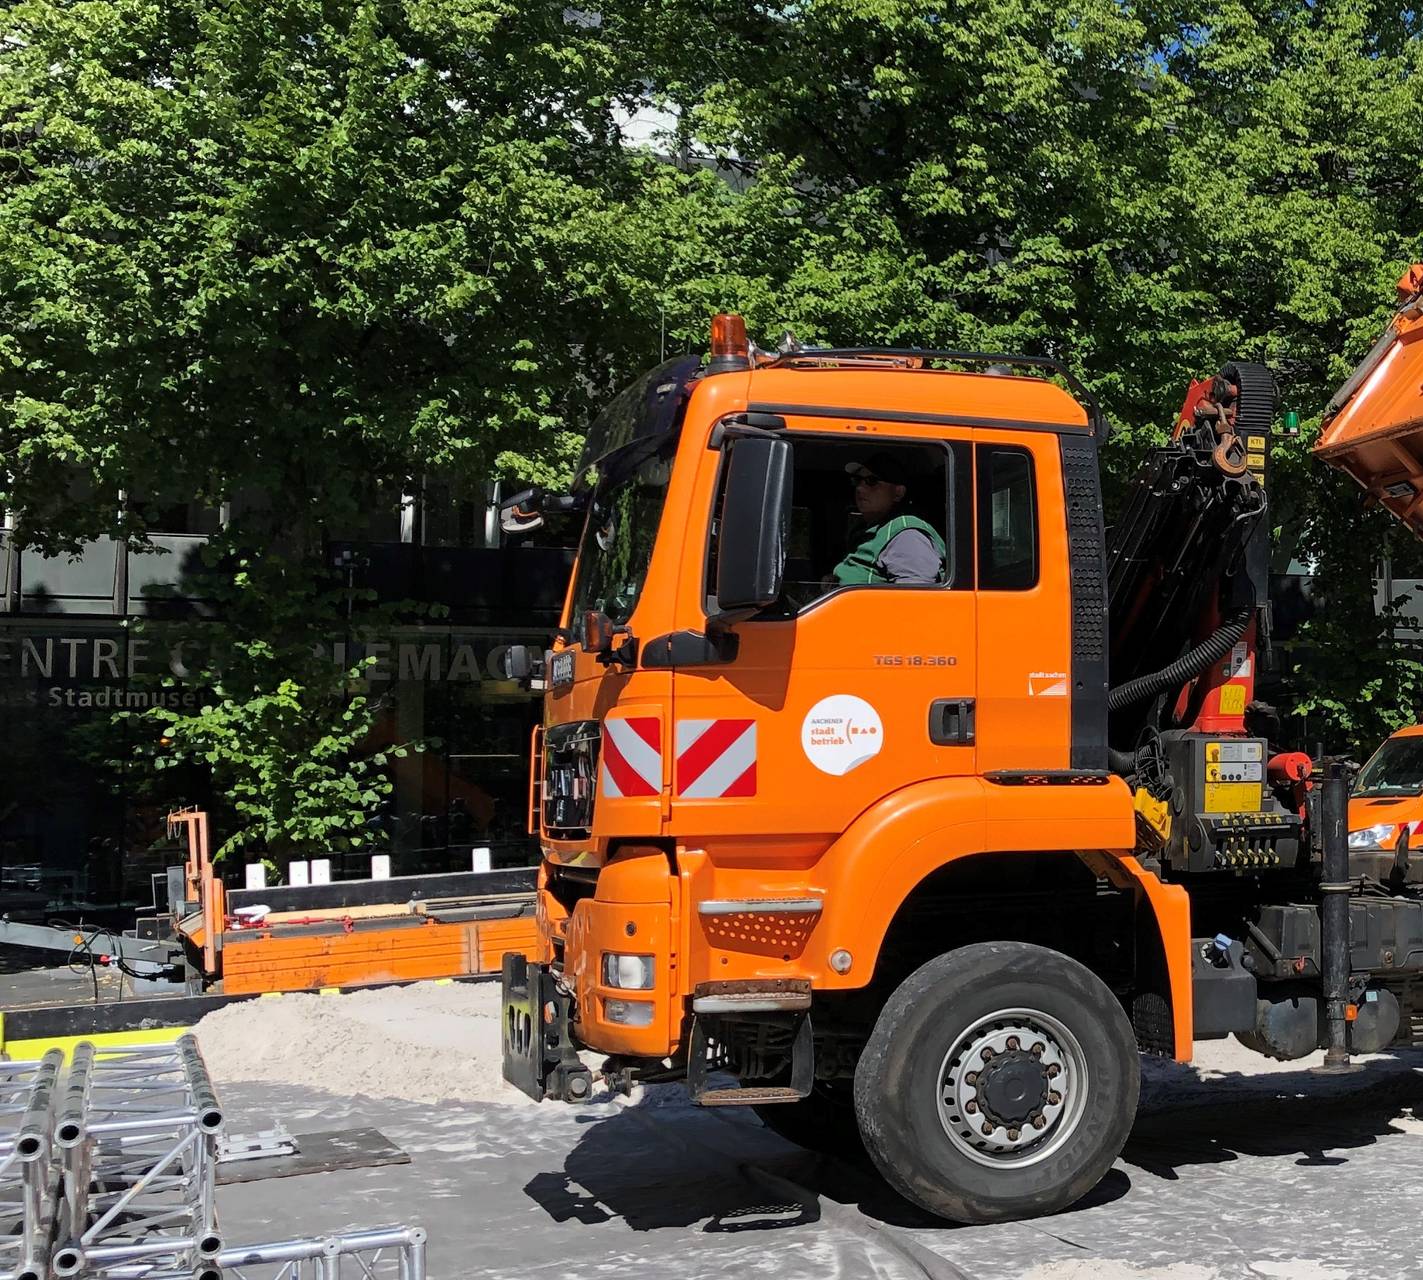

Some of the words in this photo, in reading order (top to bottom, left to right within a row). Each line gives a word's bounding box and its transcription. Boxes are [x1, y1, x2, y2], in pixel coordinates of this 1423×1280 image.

[873, 655, 903, 666] TGS
[906, 655, 958, 666] 18.360
[811, 727, 835, 735] stadt
[811, 737, 846, 745] betrieb
